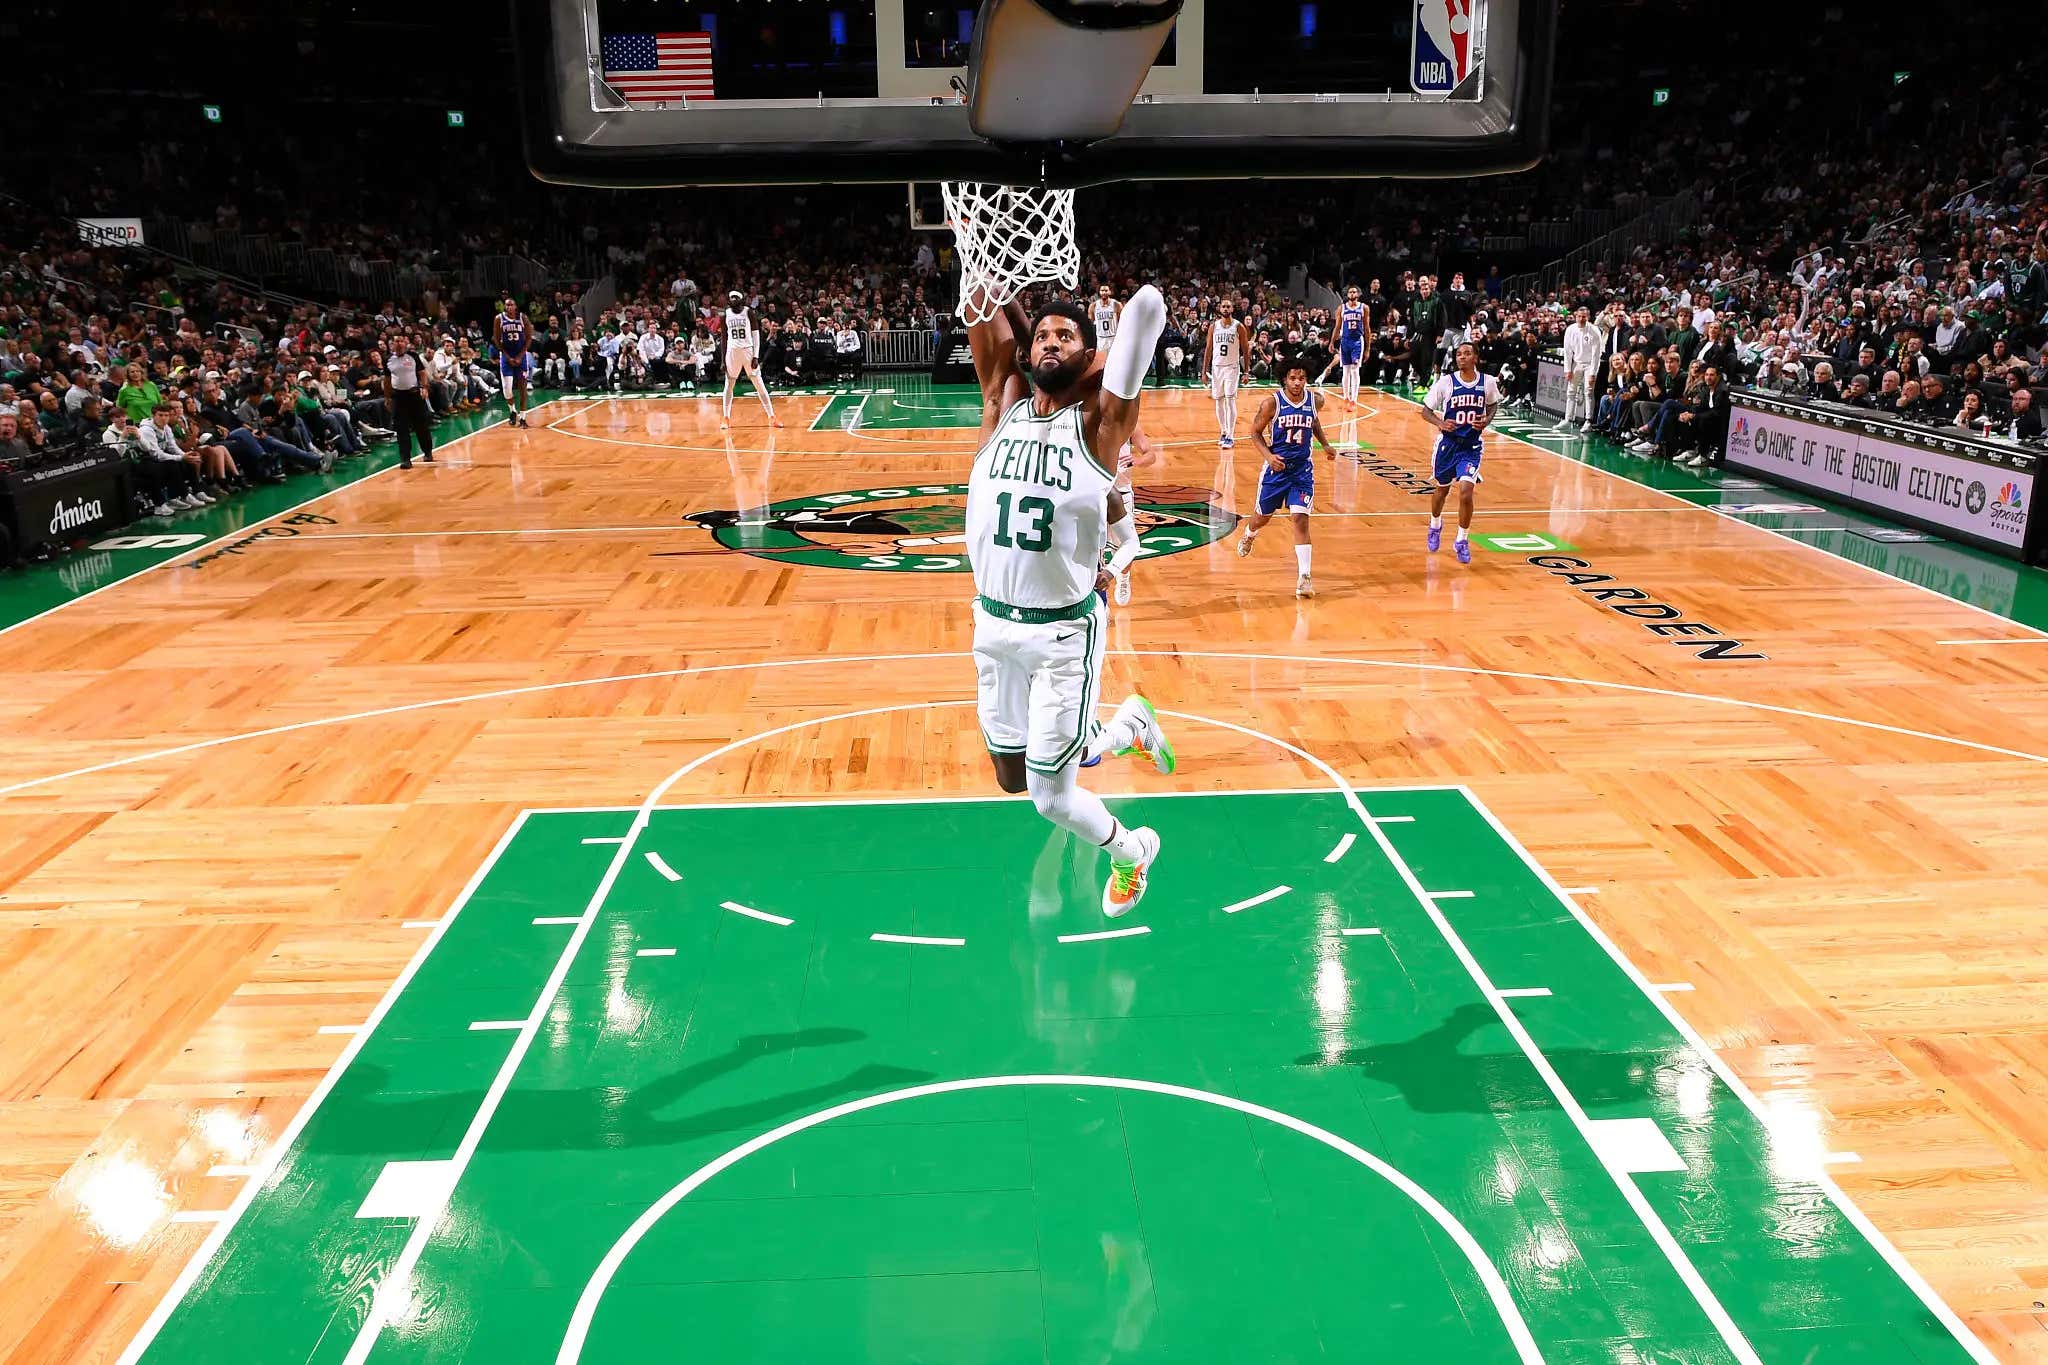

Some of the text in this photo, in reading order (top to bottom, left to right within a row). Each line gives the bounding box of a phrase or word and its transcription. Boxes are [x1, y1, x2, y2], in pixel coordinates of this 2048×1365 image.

[1420, 61, 1447, 84] NBA
[1102, 320, 1110, 331] 0
[1347, 320, 1357, 330] 12
[507, 332, 520, 341] 33
[731, 328, 746, 340] 88
[1219, 344, 1228, 357] 9
[1450, 394, 1485, 408] PHILA
[1277, 414, 1313, 428] PHILA
[1284, 428, 1303, 444] 14
[989, 438, 1074, 492] CELTICS
[1338, 450, 1437, 495] GARDEN
[1768, 431, 1797, 462] HOME
[1801, 440, 1817, 466] OF
[1823, 444, 1847, 476] THE
[1851, 452, 1902, 492] BOSTON
[1908, 466, 1964, 508] CELTICS
[49, 496, 104, 535] Amica
[1990, 500, 2027, 524] Sports
[993, 491, 1055, 553] 13
[1990, 521, 2021, 535] BOSTON
[1487, 533, 1558, 552] TD
[1526, 555, 1769, 662] GARDEN
